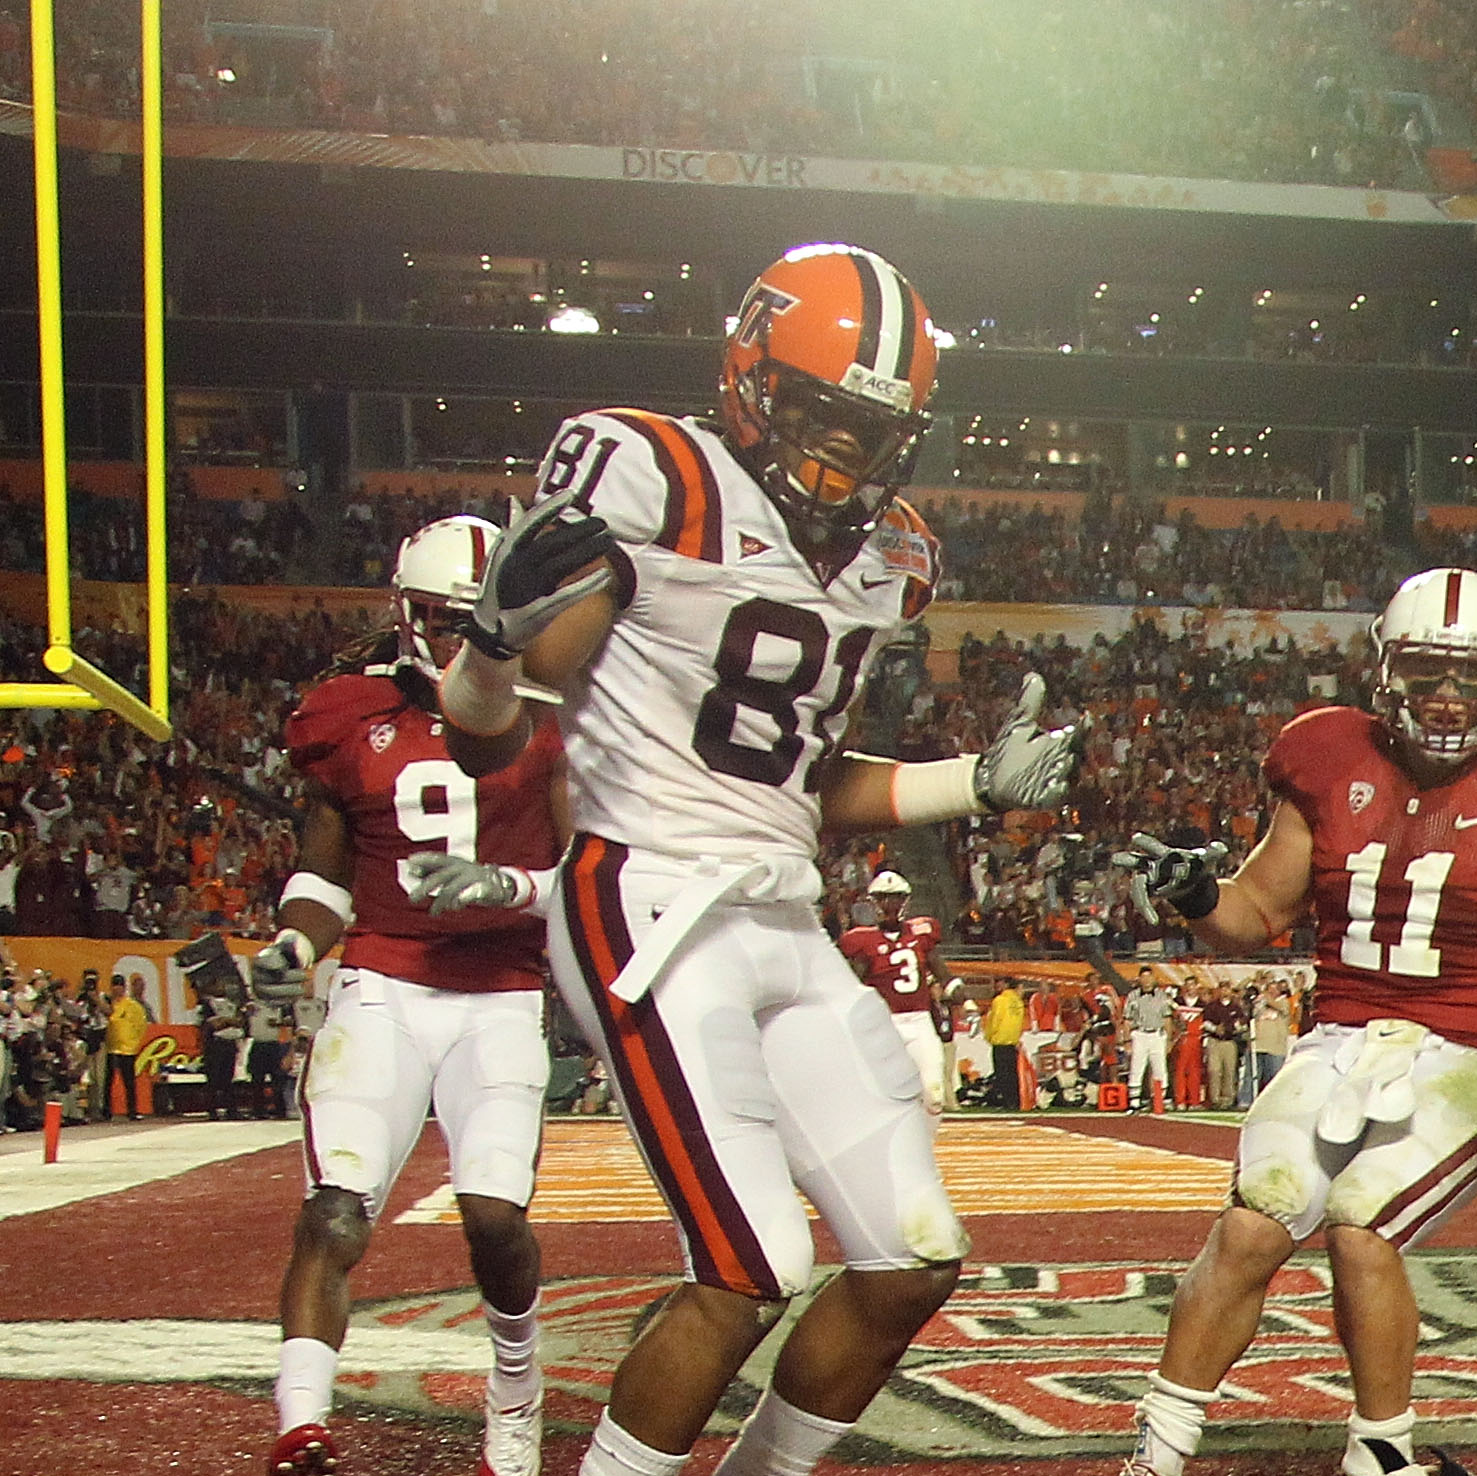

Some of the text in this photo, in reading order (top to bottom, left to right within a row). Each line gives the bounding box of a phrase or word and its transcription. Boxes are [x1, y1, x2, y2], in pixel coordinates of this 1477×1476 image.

[622, 149, 806, 184] DISCOVER
[864, 376, 896, 395] ACC
[541, 424, 622, 516] 81
[690, 596, 877, 793] 81
[394, 759, 478, 896] 9
[1340, 841, 1456, 979] 11
[889, 948, 921, 994] 3
[1103, 1086, 1121, 1107] G
